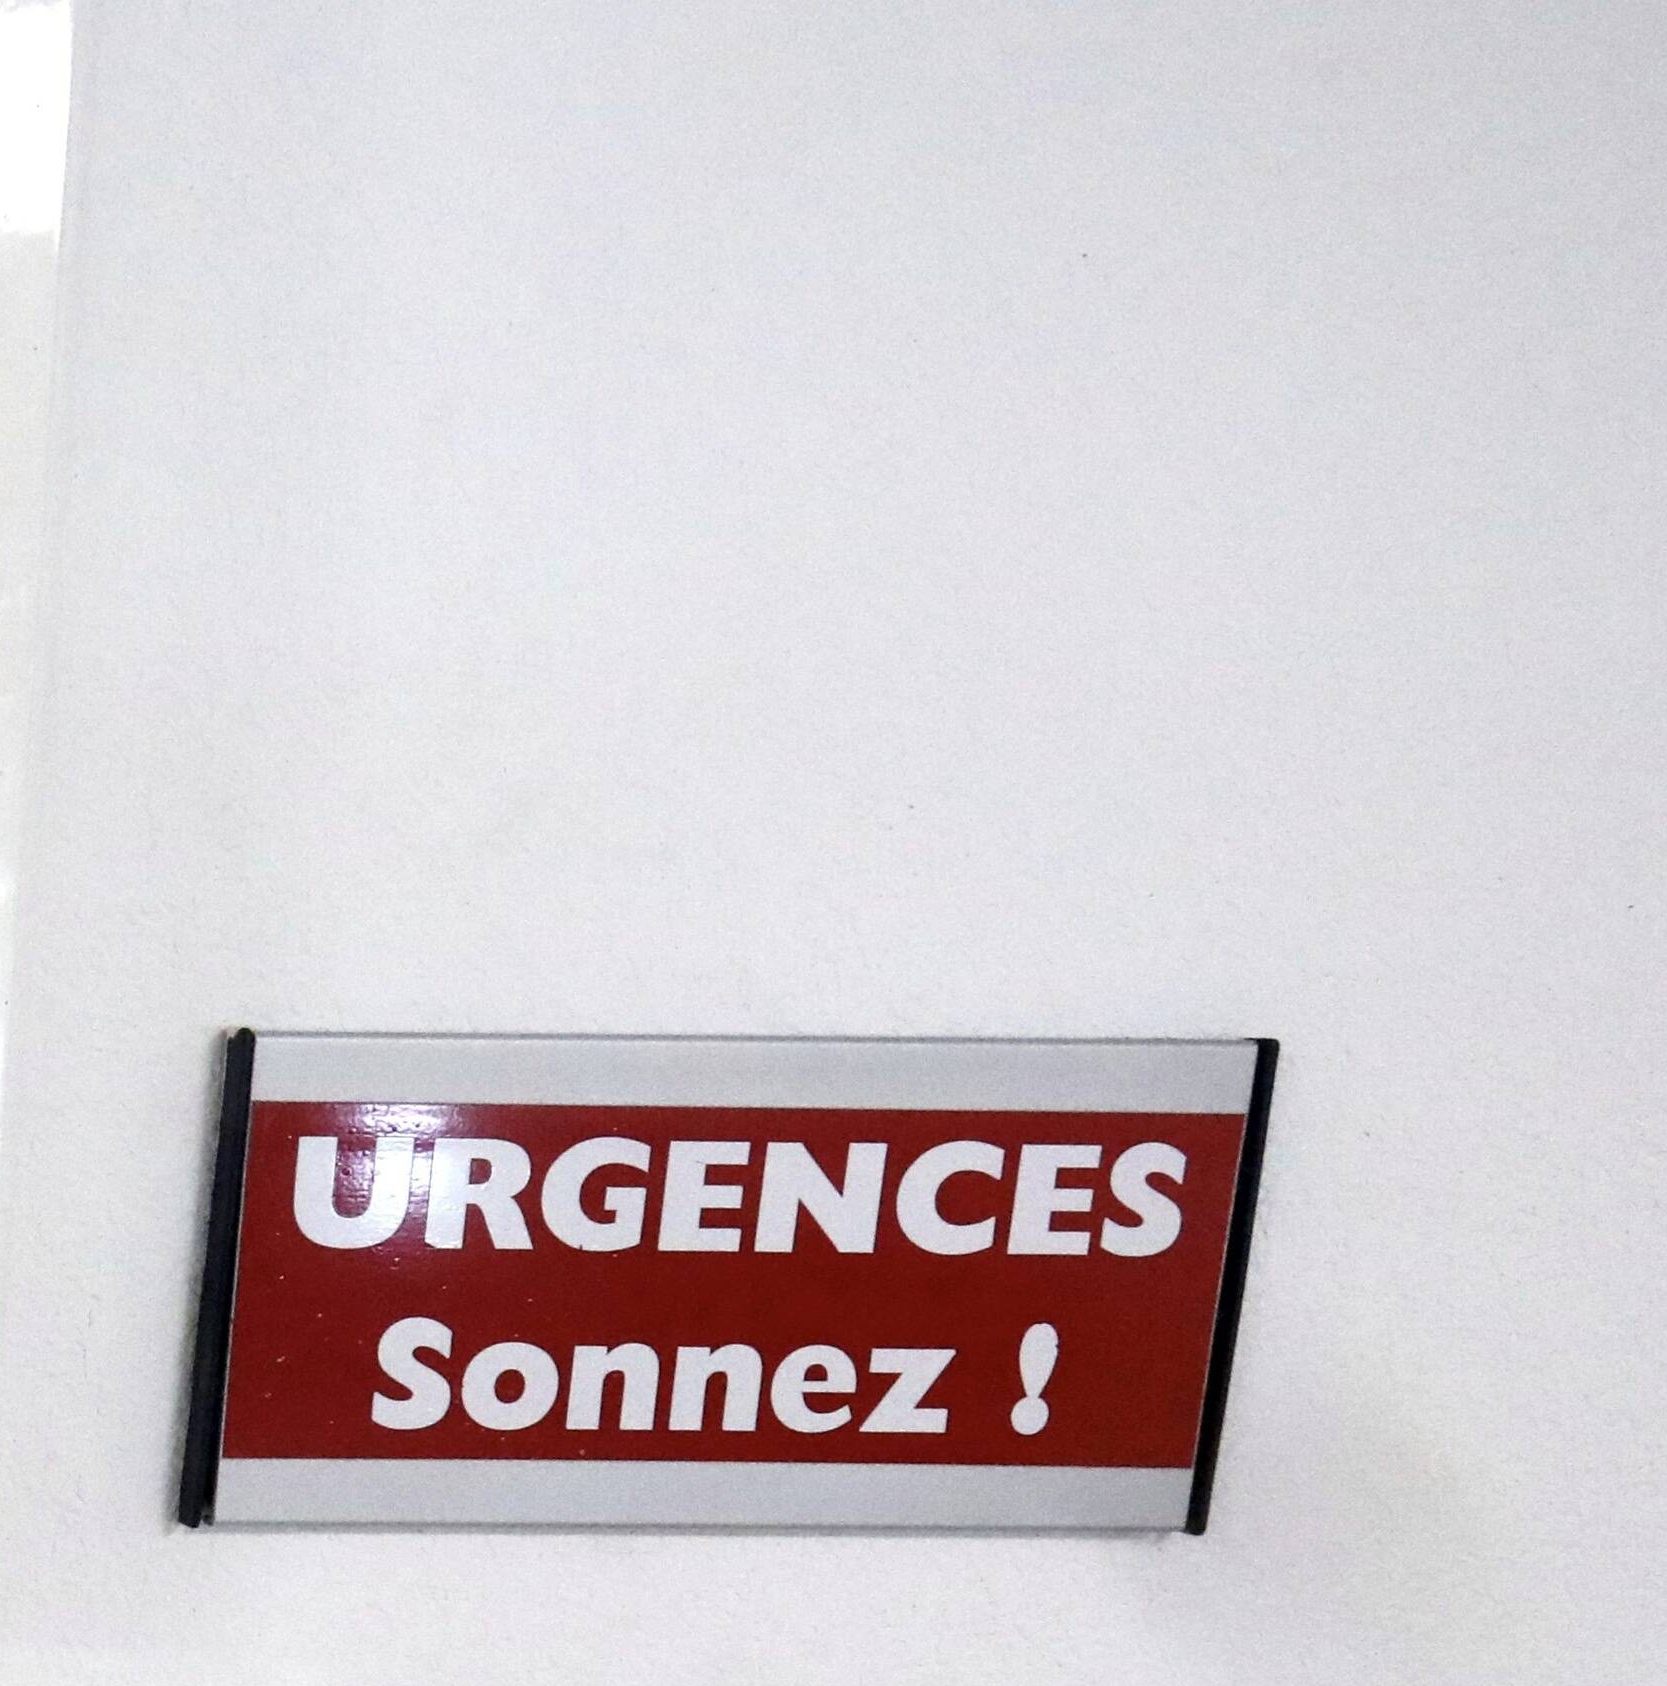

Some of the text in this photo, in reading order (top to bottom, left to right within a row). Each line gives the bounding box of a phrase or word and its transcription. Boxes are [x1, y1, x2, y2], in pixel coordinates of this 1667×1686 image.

[293, 1135, 1187, 1257] URGENCES
[371, 1316, 1060, 1436] Sonnez !
